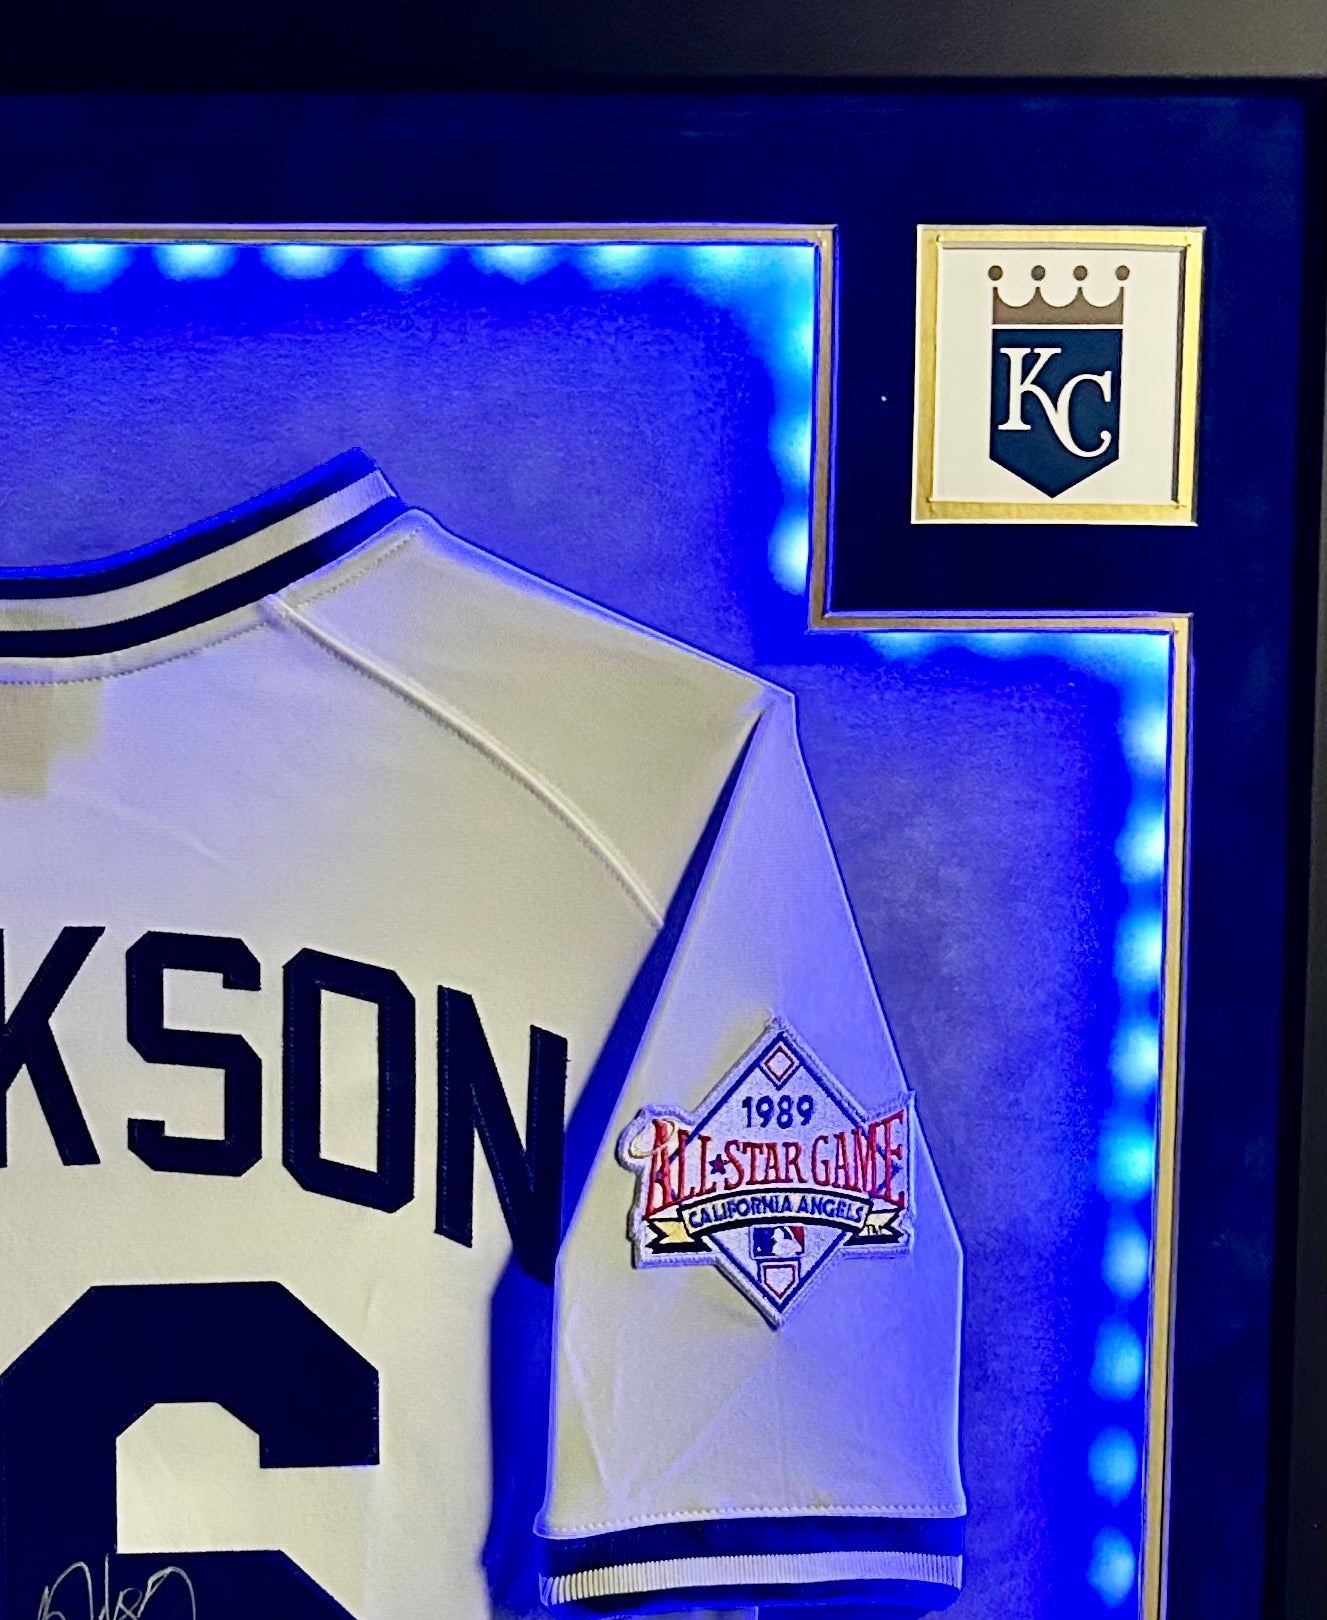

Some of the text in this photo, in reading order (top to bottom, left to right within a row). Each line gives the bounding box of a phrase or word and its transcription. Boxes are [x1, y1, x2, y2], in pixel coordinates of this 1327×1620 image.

[998, 347, 1112, 458] KC
[742, 1094, 814, 1130] 1989
[811, 1109, 905, 1207] GAME
[689, 1195, 864, 1229] CALIFORNIA ANGELS
